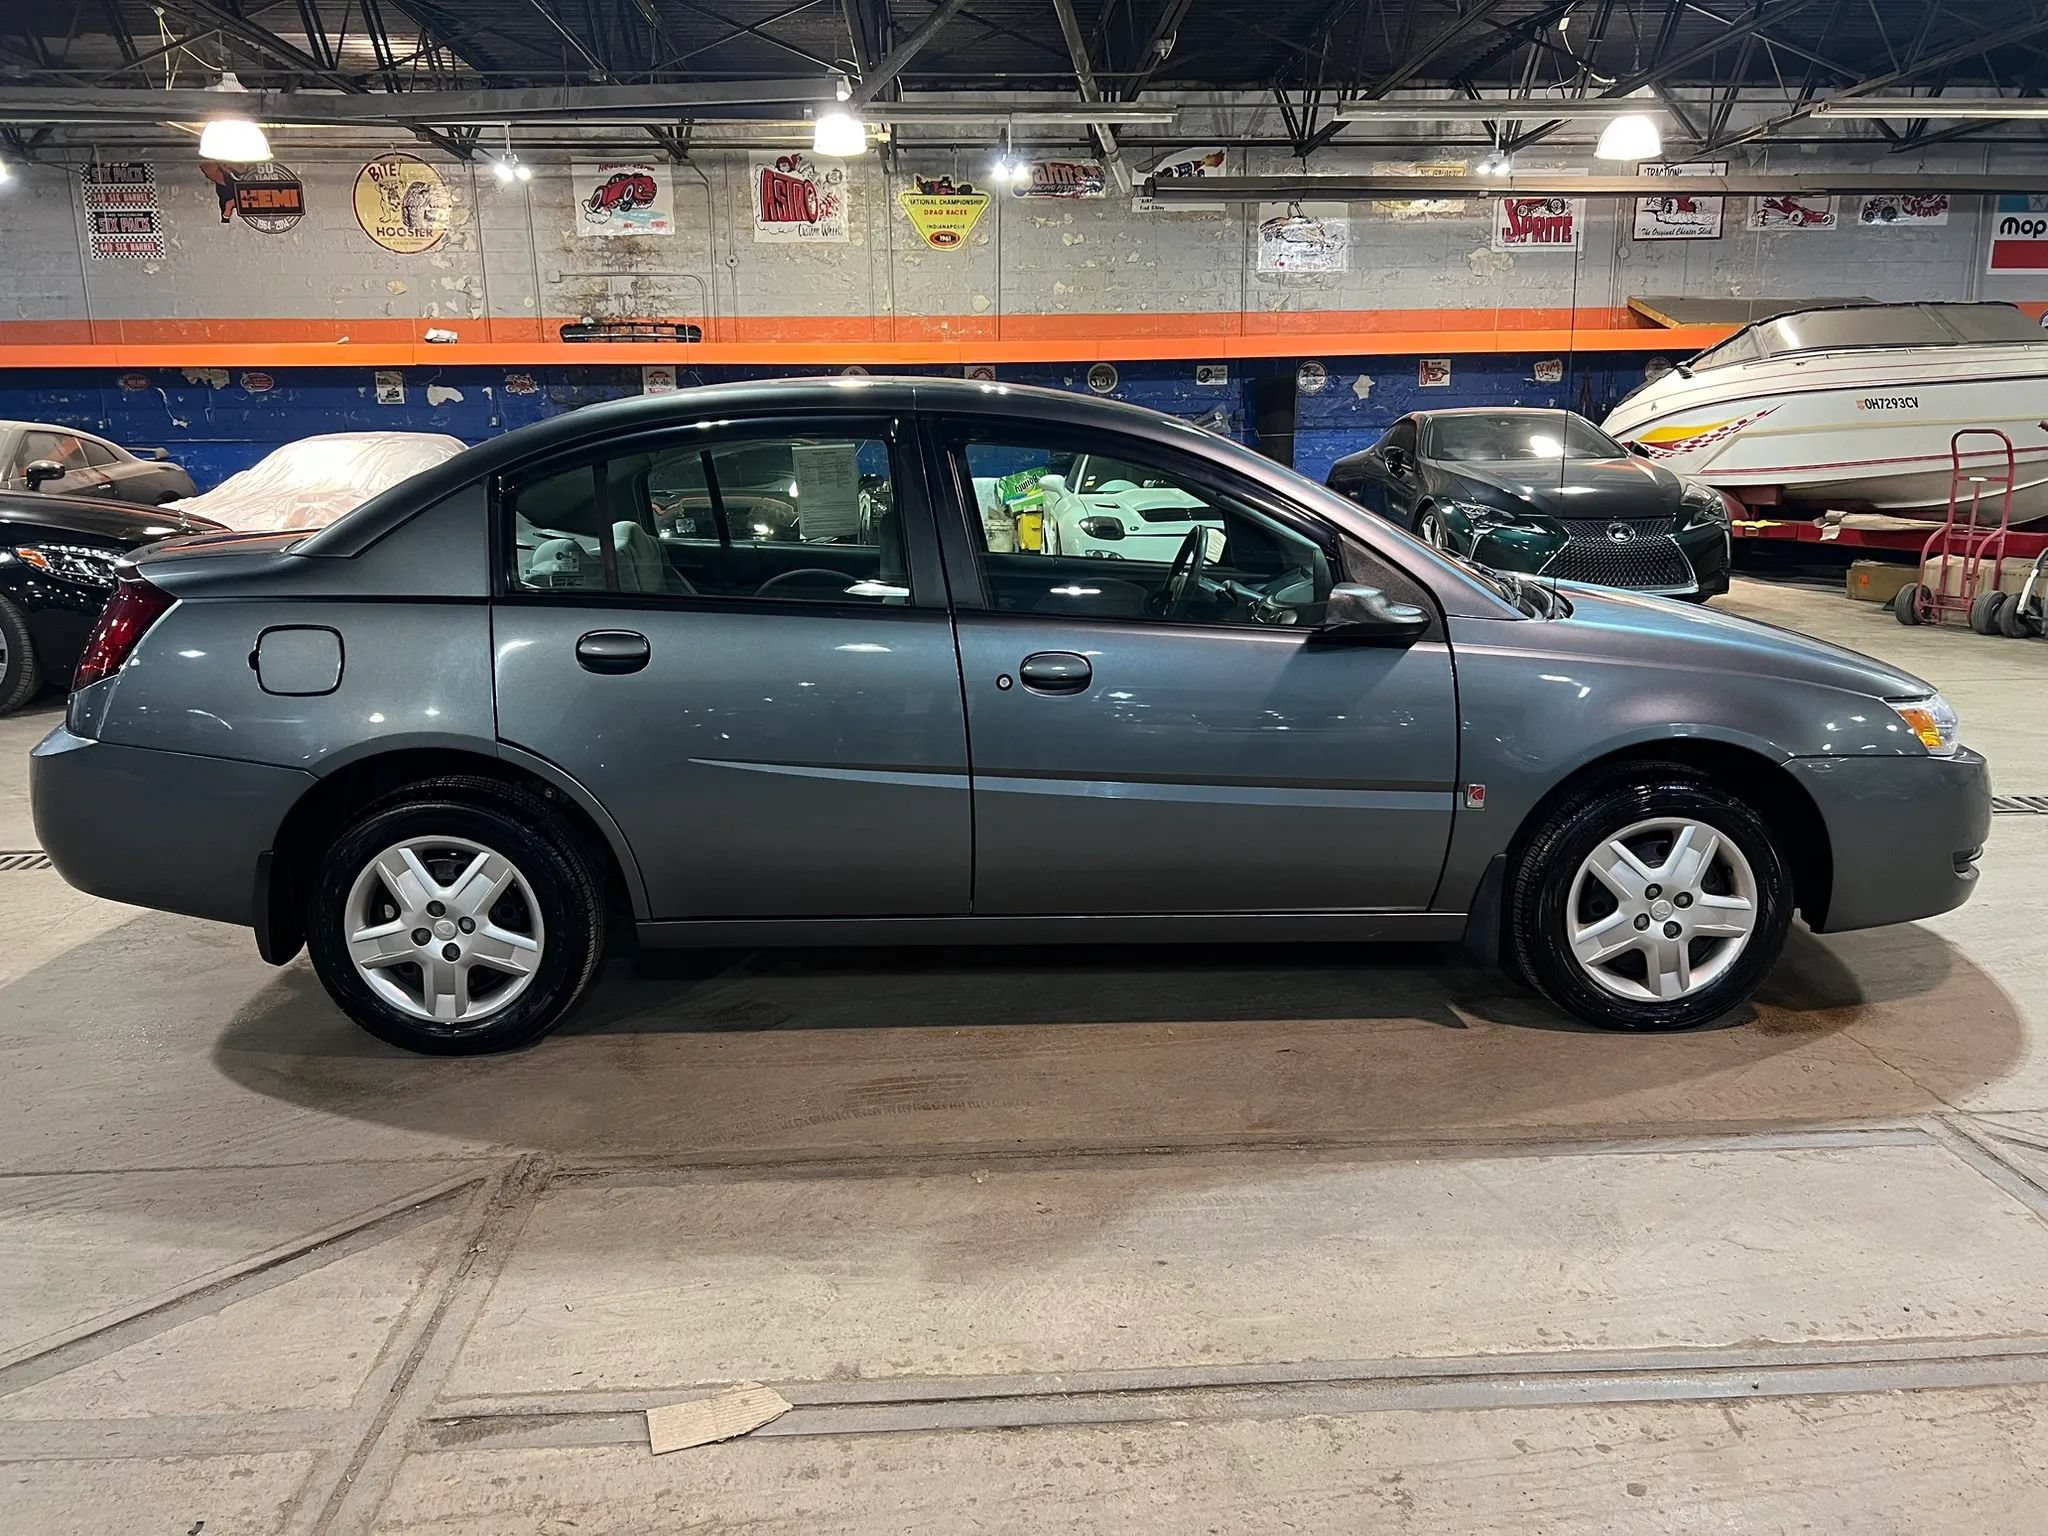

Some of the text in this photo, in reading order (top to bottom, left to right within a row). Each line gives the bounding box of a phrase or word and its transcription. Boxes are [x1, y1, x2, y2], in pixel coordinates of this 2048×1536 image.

[91, 167, 144, 182] SIX PACK
[256, 163, 274, 174] 50
[108, 193, 121, 201] SIX
[123, 193, 149, 201] BARREL
[240, 189, 299, 209] HEMI
[760, 167, 819, 224] ASTRO
[98, 217, 151, 232] SIX PACK
[257, 218, 290, 230] 1964-2014
[376, 227, 433, 238] HOOSIER
[100, 243, 156, 252] 440 SIX BARREL
[1864, 397, 1919, 409] OH7293CV
[1014, 473, 1039, 493] Bounty
